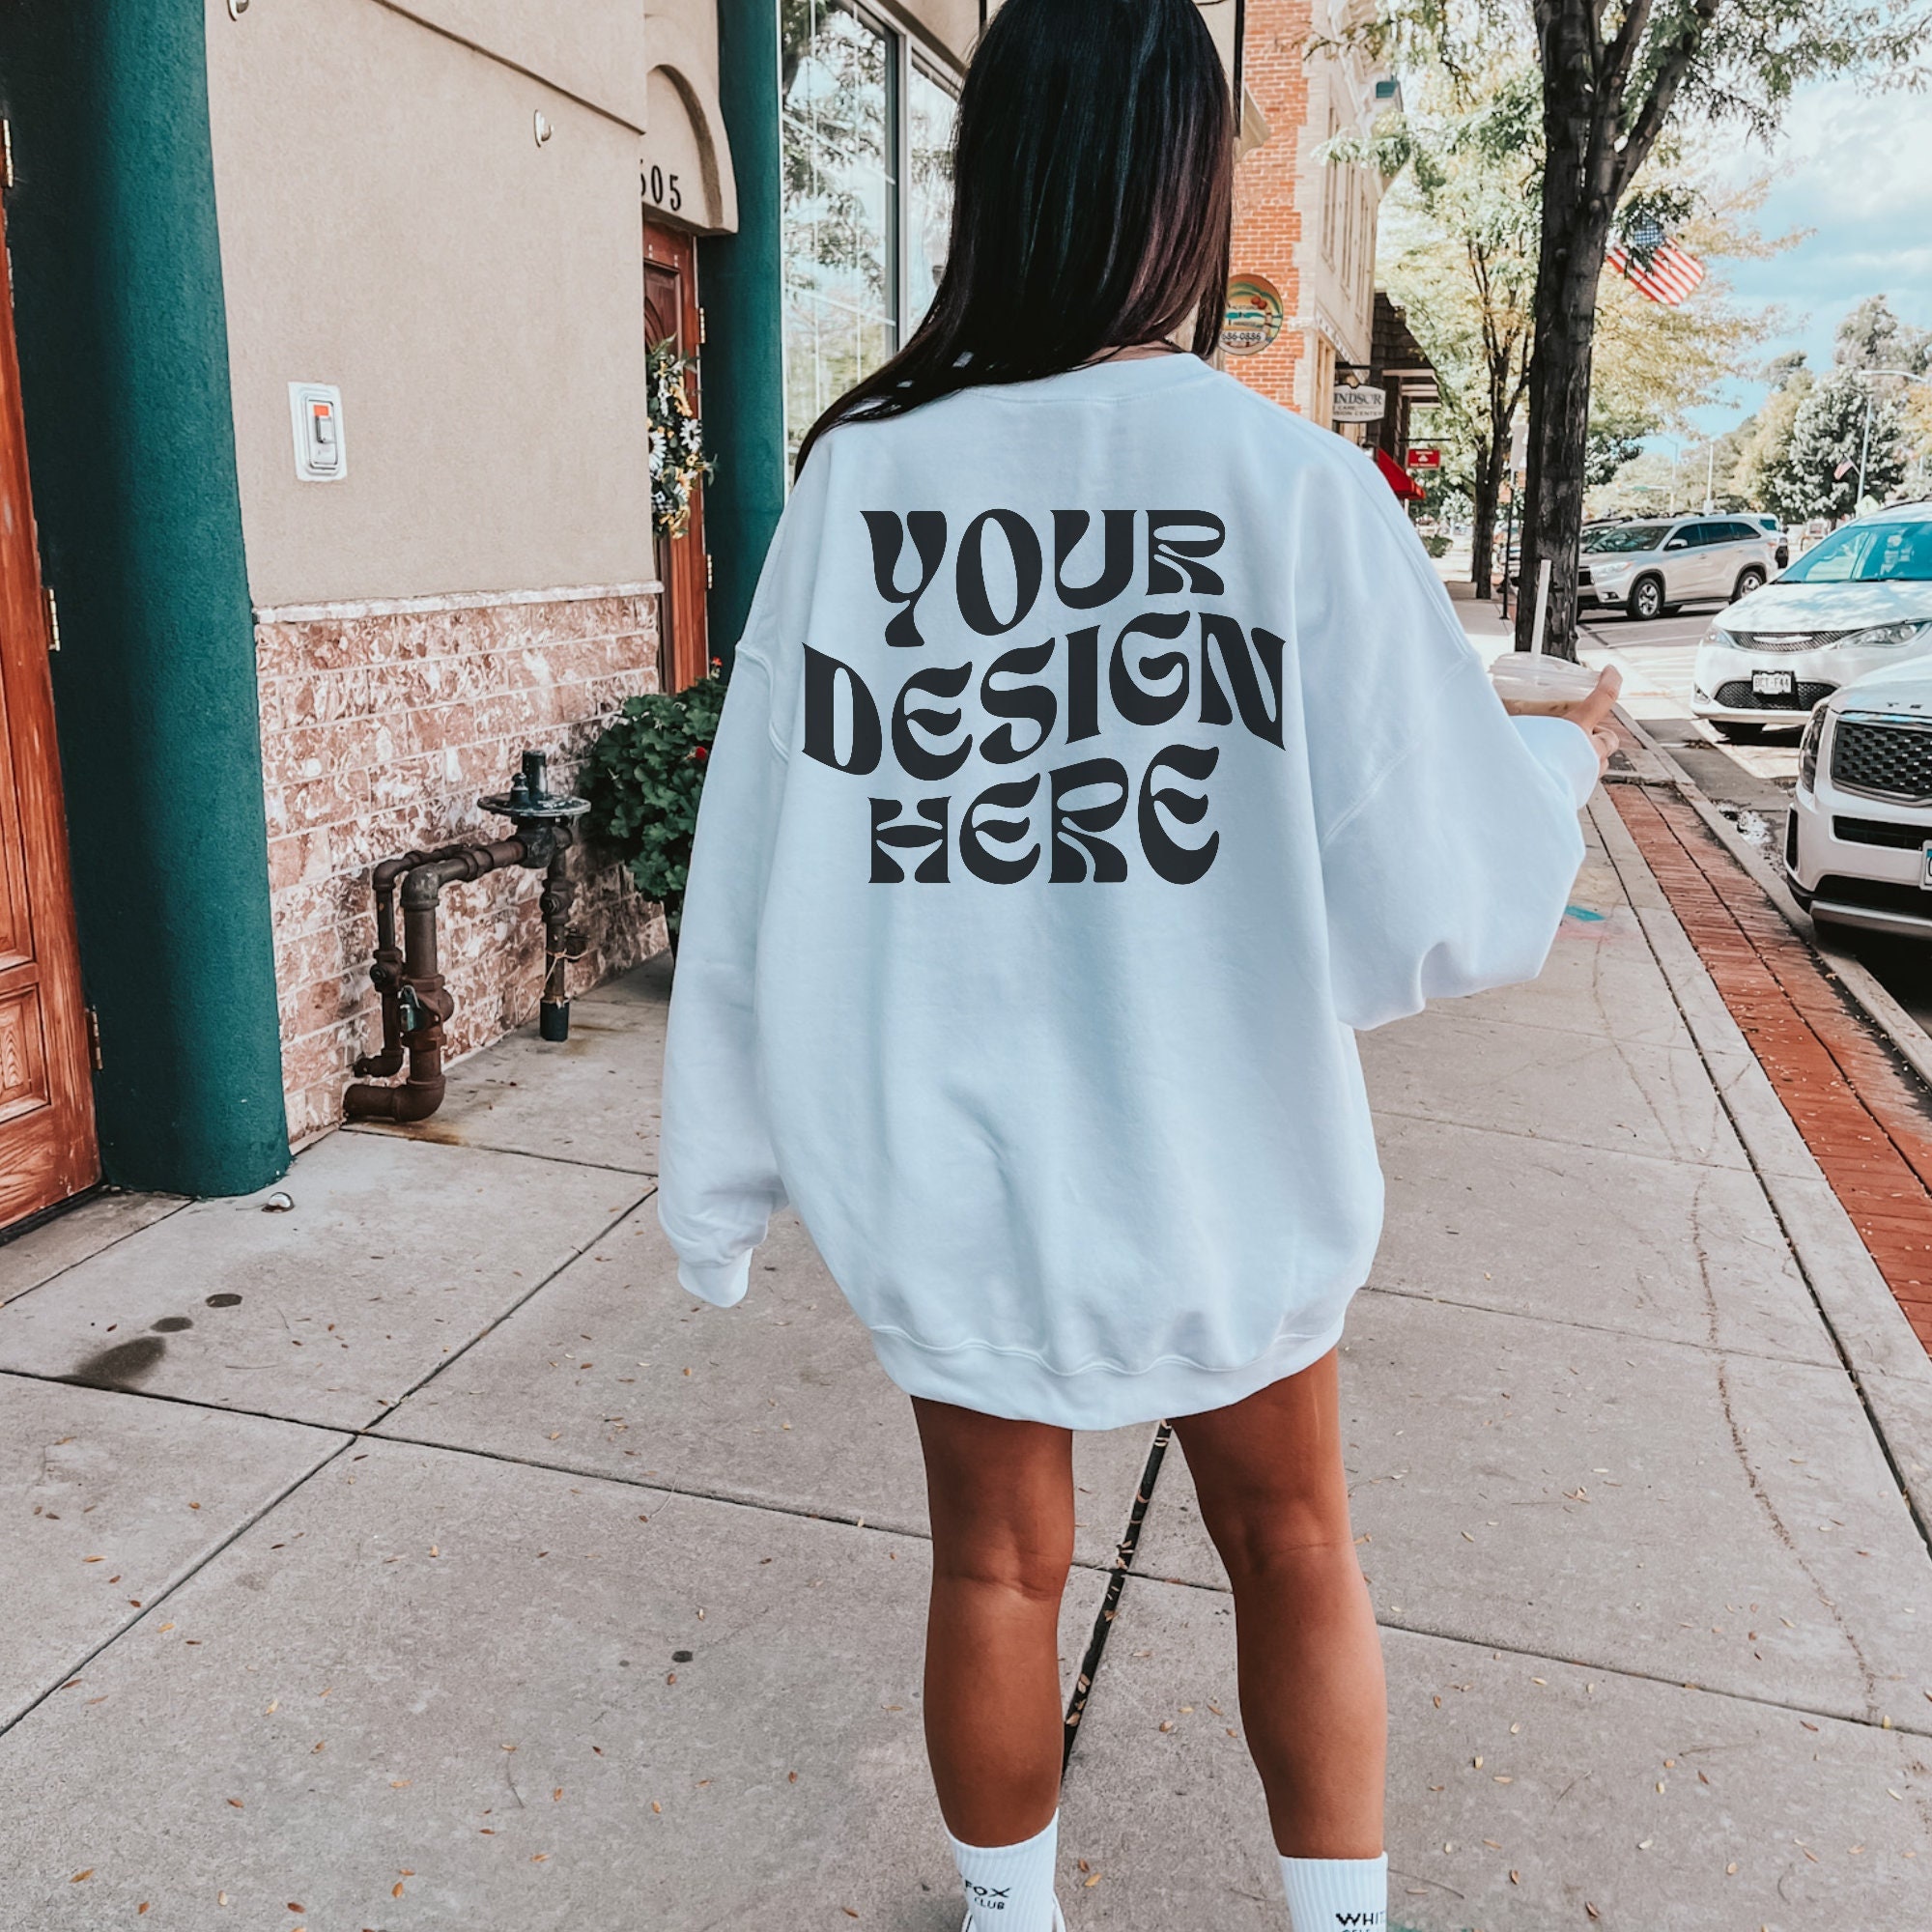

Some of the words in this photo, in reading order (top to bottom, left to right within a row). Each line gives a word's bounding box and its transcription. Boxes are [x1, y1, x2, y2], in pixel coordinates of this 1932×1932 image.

[860, 508, 1226, 647] YOUR
[802, 611, 1286, 781] DESIGN
[867, 744, 1219, 885] HERE
[965, 1879, 1011, 1898] FOX
[974, 1896, 1005, 1910] CLUB
